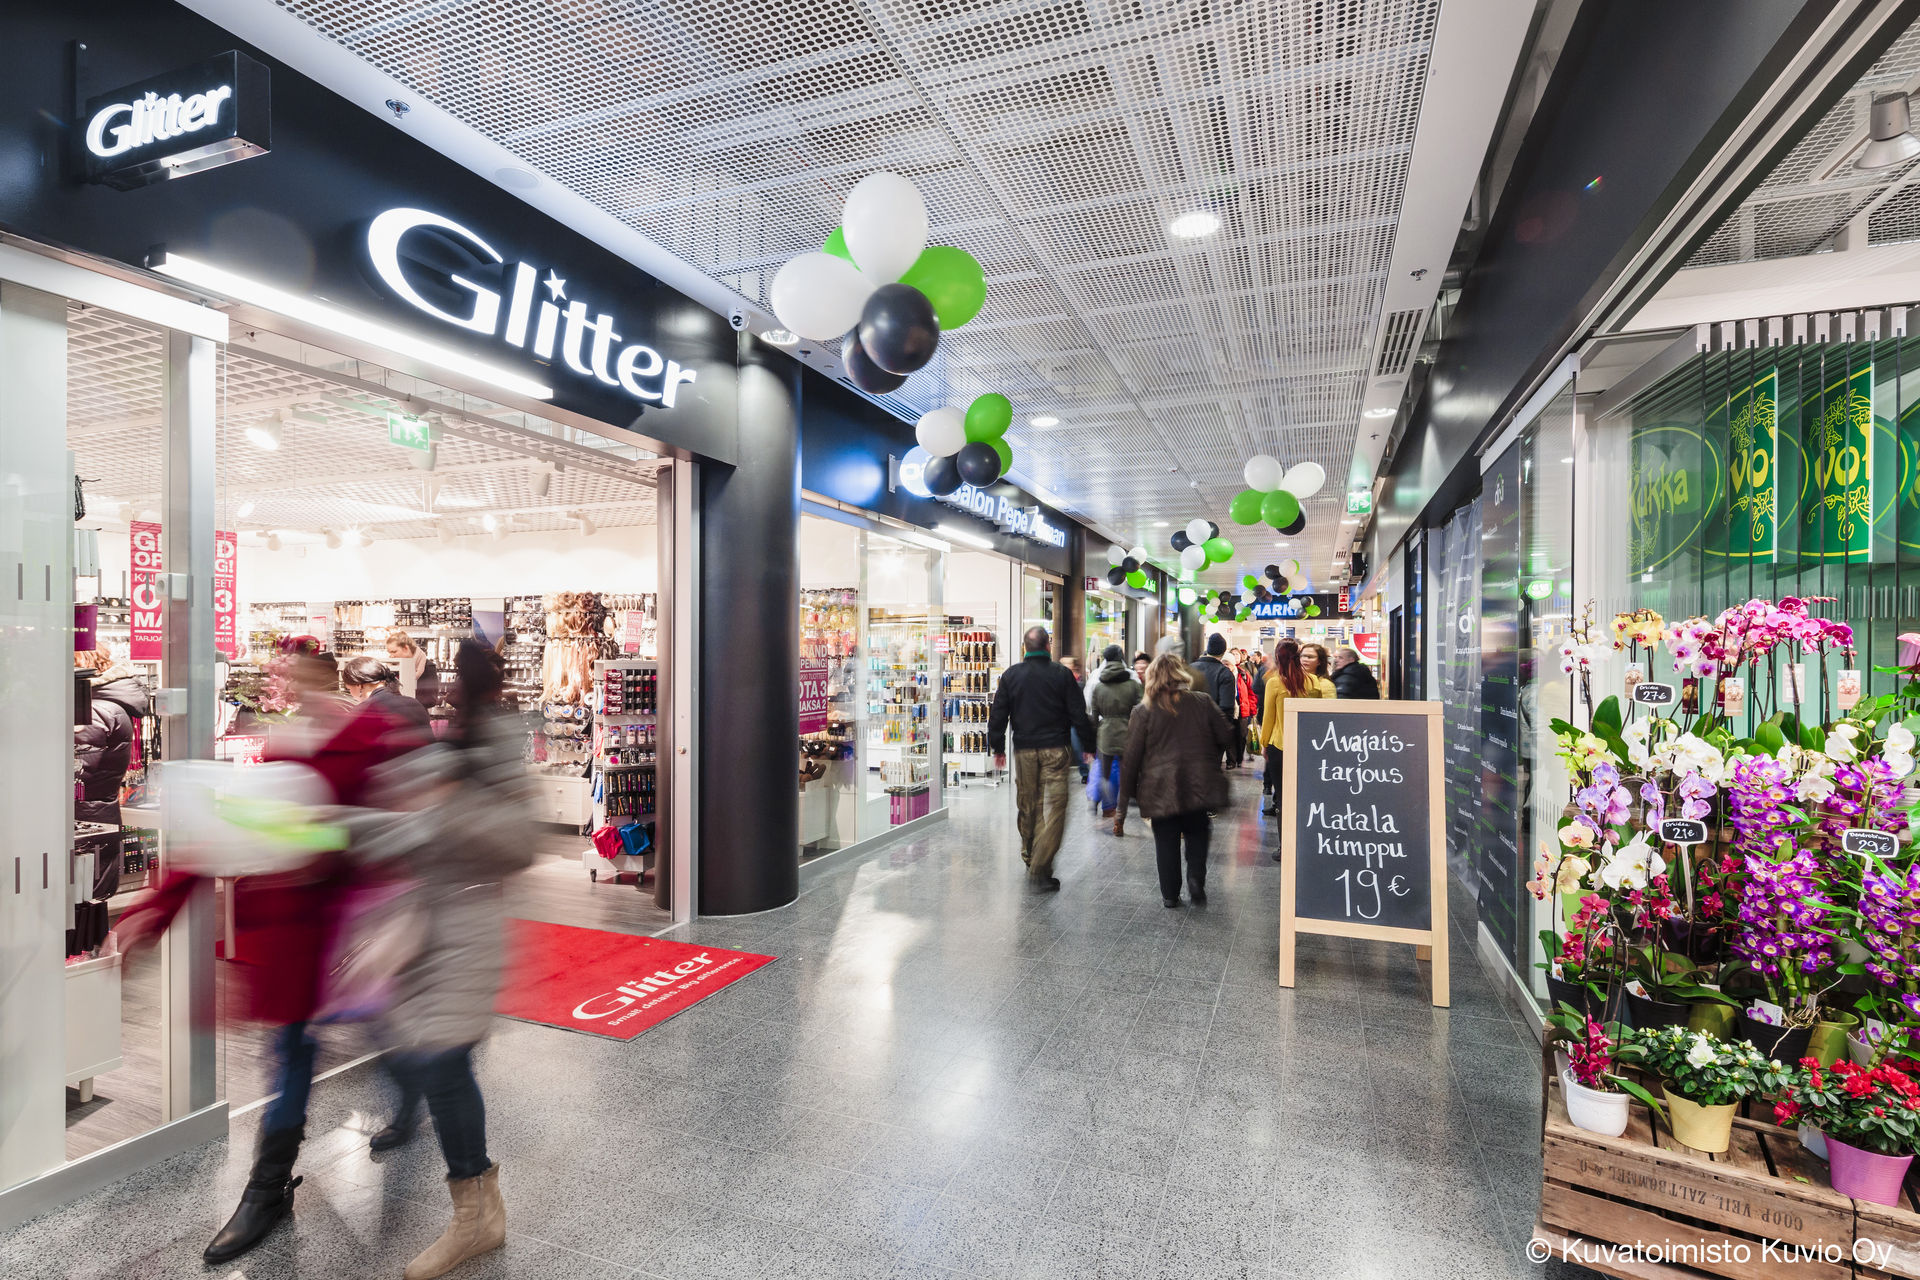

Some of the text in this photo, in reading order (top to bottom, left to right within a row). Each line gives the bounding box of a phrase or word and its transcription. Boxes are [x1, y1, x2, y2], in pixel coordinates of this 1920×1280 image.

[86, 83, 231, 158] Glitter
[367, 207, 698, 409] Glitter
[997, 495, 1028, 533] Pepe
[800, 644, 827, 658] RAND
[800, 658, 827, 669] PENING!
[1312, 721, 1416, 763] Avajais-
[1318, 759, 1403, 795] tarjous
[1306, 802, 1400, 834] Matala
[1317, 833, 1407, 868] kimppu
[572, 952, 713, 1019] Glitter
[607, 1008, 642, 1026] Small
